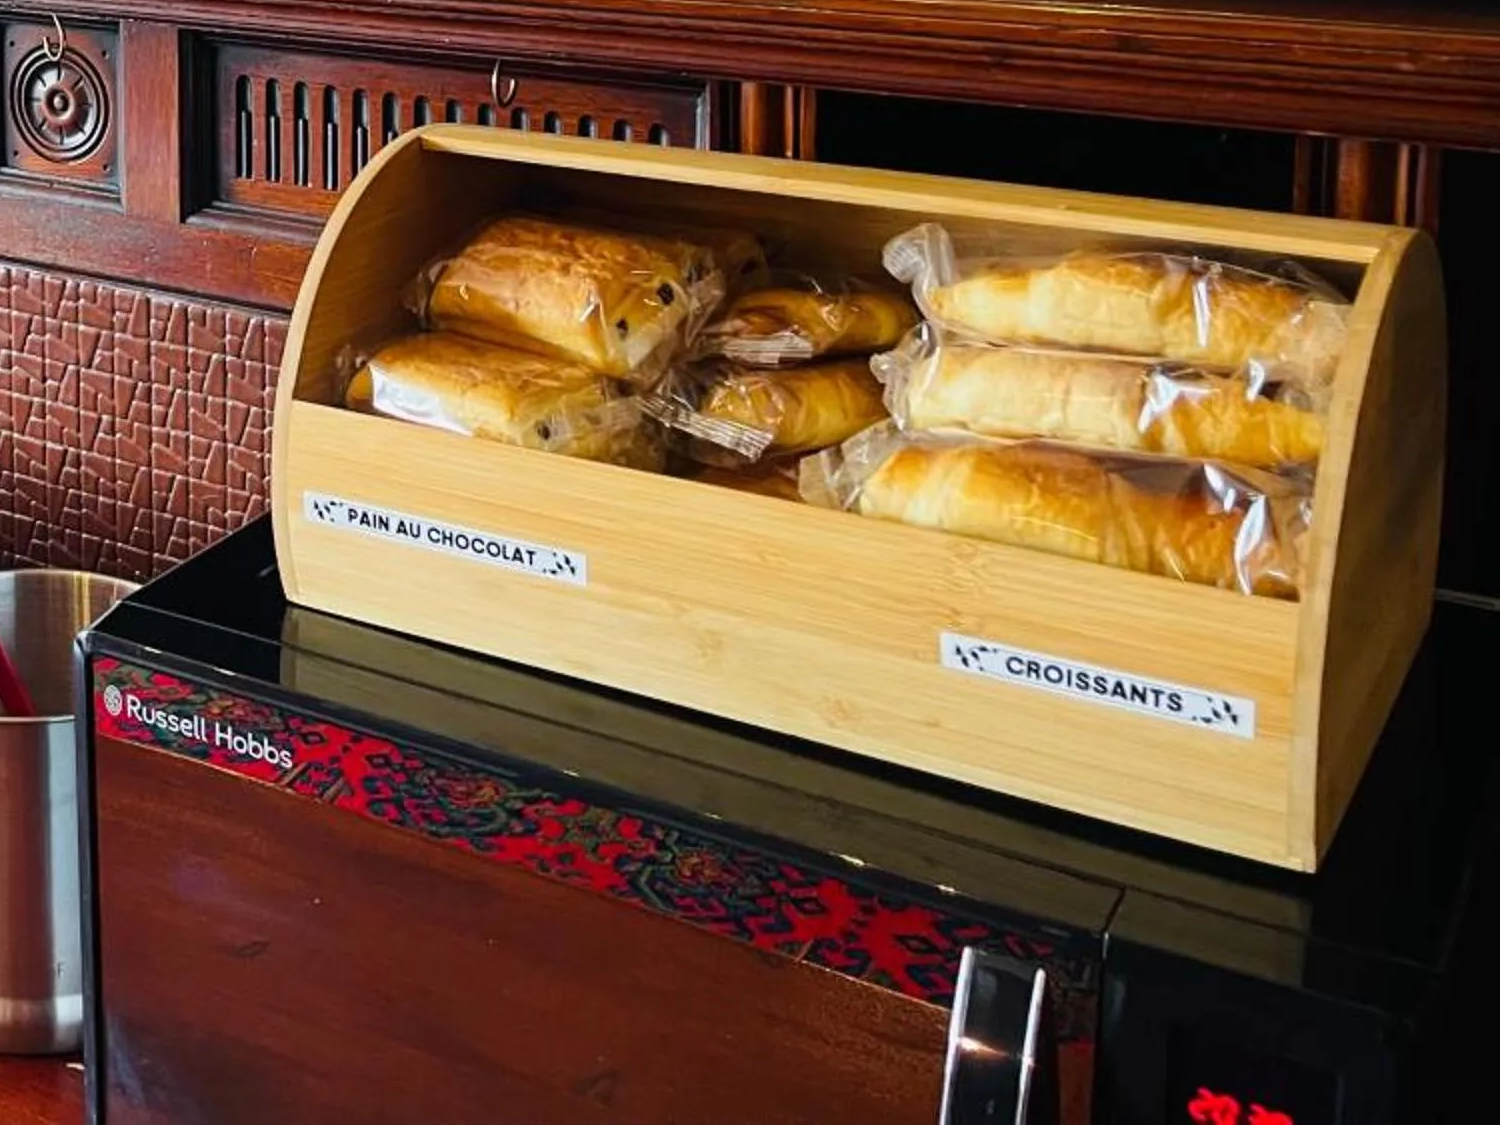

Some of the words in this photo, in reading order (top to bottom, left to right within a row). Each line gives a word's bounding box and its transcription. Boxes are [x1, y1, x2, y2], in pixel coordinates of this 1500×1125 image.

[347, 508, 390, 531] PAIN
[395, 520, 422, 539] AU
[427, 527, 537, 567] CHOCOLAT
[1005, 656, 1184, 713] CROISSANTS
[126, 694, 208, 743] Russell
[215, 722, 293, 769] Hobbs
